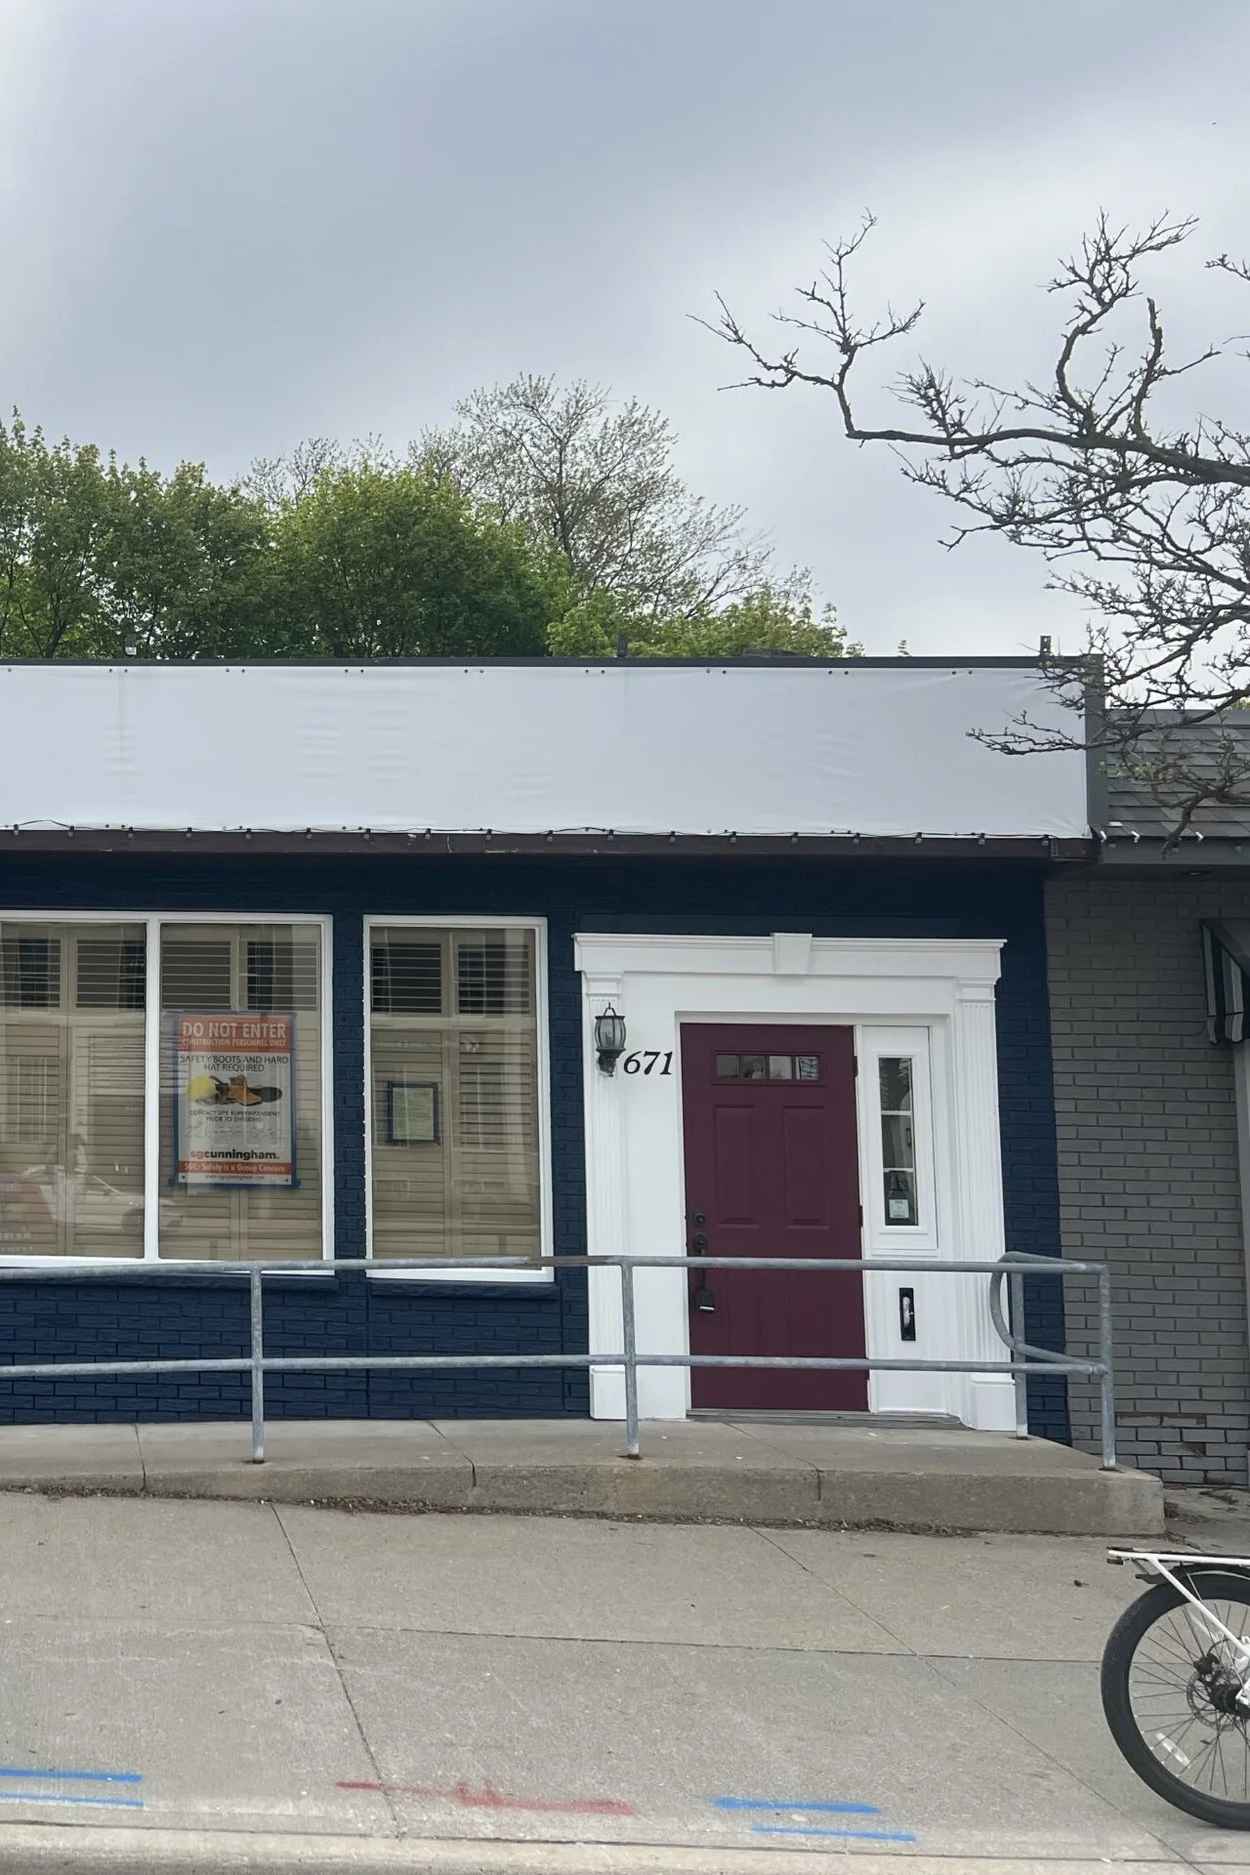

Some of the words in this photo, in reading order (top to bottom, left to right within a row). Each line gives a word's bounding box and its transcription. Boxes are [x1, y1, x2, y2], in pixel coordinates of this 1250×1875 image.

[182, 1022, 204, 1037] DO
[210, 1022, 237, 1038] NOT
[242, 1023, 286, 1039] ENTER
[182, 1038, 230, 1046] CONSTRUCTION
[232, 1039, 268, 1047] PERSONNEL
[180, 1055, 211, 1063] SAFETY
[213, 1055, 241, 1063] BOOTS
[243, 1056, 263, 1064] AND
[264, 1056, 289, 1064] HARD
[623, 1050, 673, 1075] 671
[204, 1063, 221, 1071] HAT
[222, 1064, 265, 1072] REQUIRED
[202, 1163, 222, 1172] Safety
[237, 1164, 258, 1173] Group
